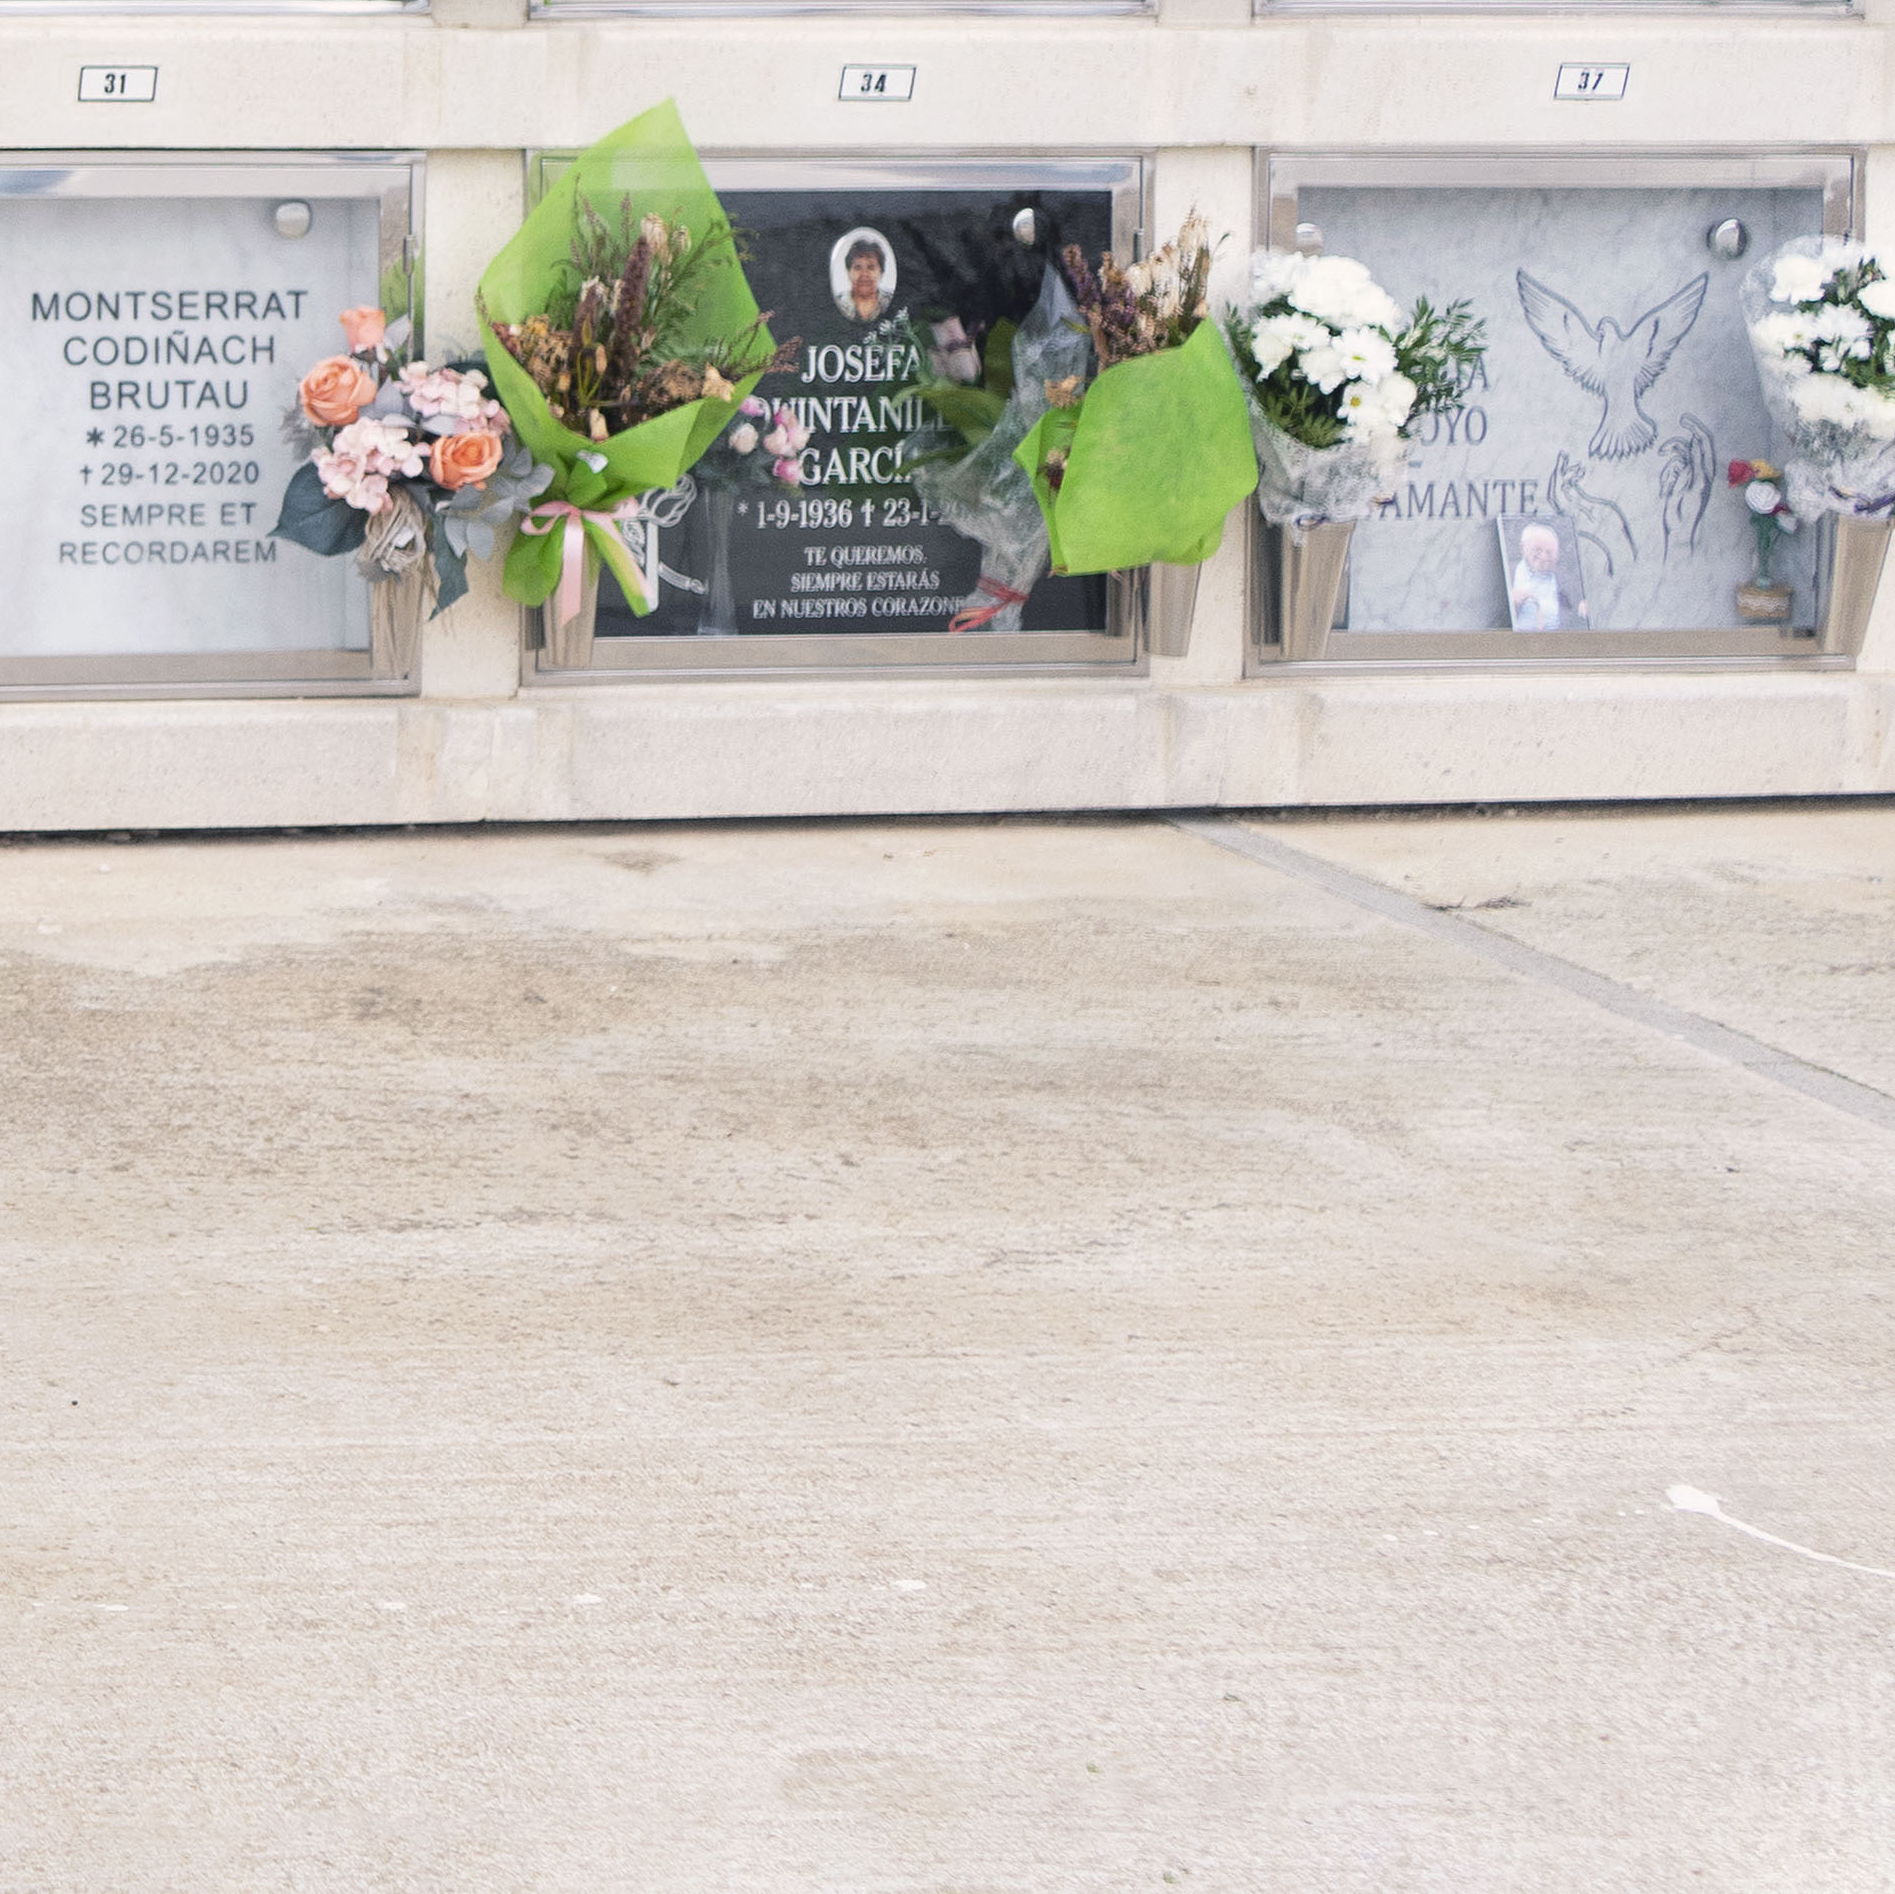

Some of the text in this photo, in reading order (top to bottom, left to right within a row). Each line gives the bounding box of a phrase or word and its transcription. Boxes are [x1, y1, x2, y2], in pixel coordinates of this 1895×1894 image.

[104, 73, 126, 95] 31
[860, 72, 886, 94] 34
[32, 290, 308, 322] MONTSERRAT
[63, 330, 275, 366] CODIÑACH
[89, 380, 249, 410] BRUTAU
[113, 423, 254, 448] 26-5-1935
[101, 461, 260, 486] 29-12-2020
[80, 502, 257, 527] SEMPRE ET
[59, 541, 277, 565] RECORDAREM
[804, 546, 827, 566] TE
[790, 567, 940, 593] SIEMPRE ESTARÁS
[753, 599, 775, 619] EN
[780, 597, 867, 618] NUESTROS
